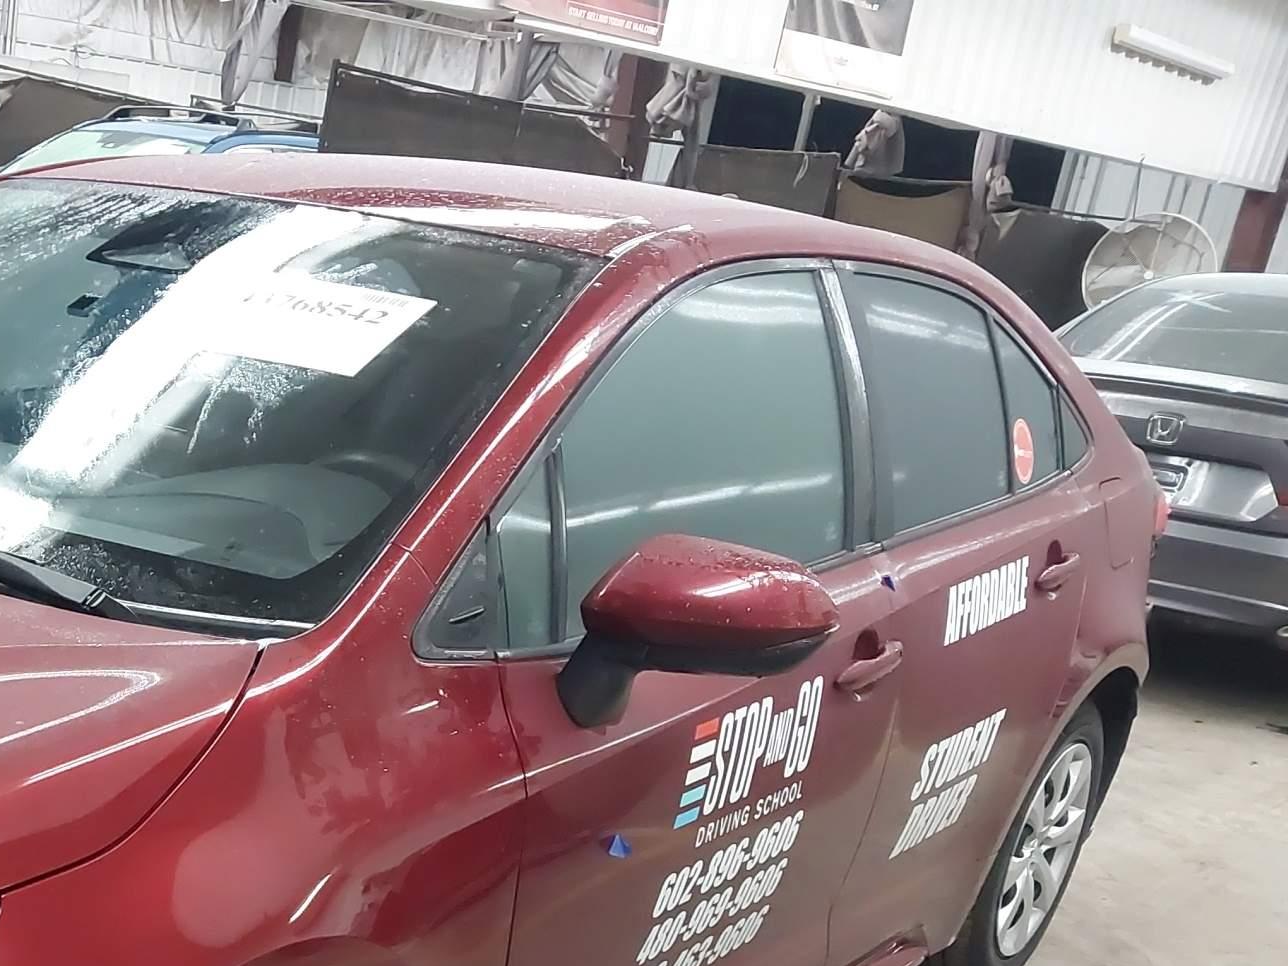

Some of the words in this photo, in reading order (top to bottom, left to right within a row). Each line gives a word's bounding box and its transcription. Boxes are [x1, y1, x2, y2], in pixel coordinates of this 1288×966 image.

[943, 556, 1030, 646] AFFORDABLE
[702, 696, 774, 816] STOP
[763, 708, 795, 768] AND
[783, 675, 824, 778] GO
[910, 708, 1008, 801] STUDENT
[695, 805, 751, 848] DRIVING
[753, 780, 803, 820] SCHOOL
[888, 774, 978, 860] DRIVER
[652, 810, 804, 918] 602-896-9606
[635, 857, 788, 966] 480-969-9606
